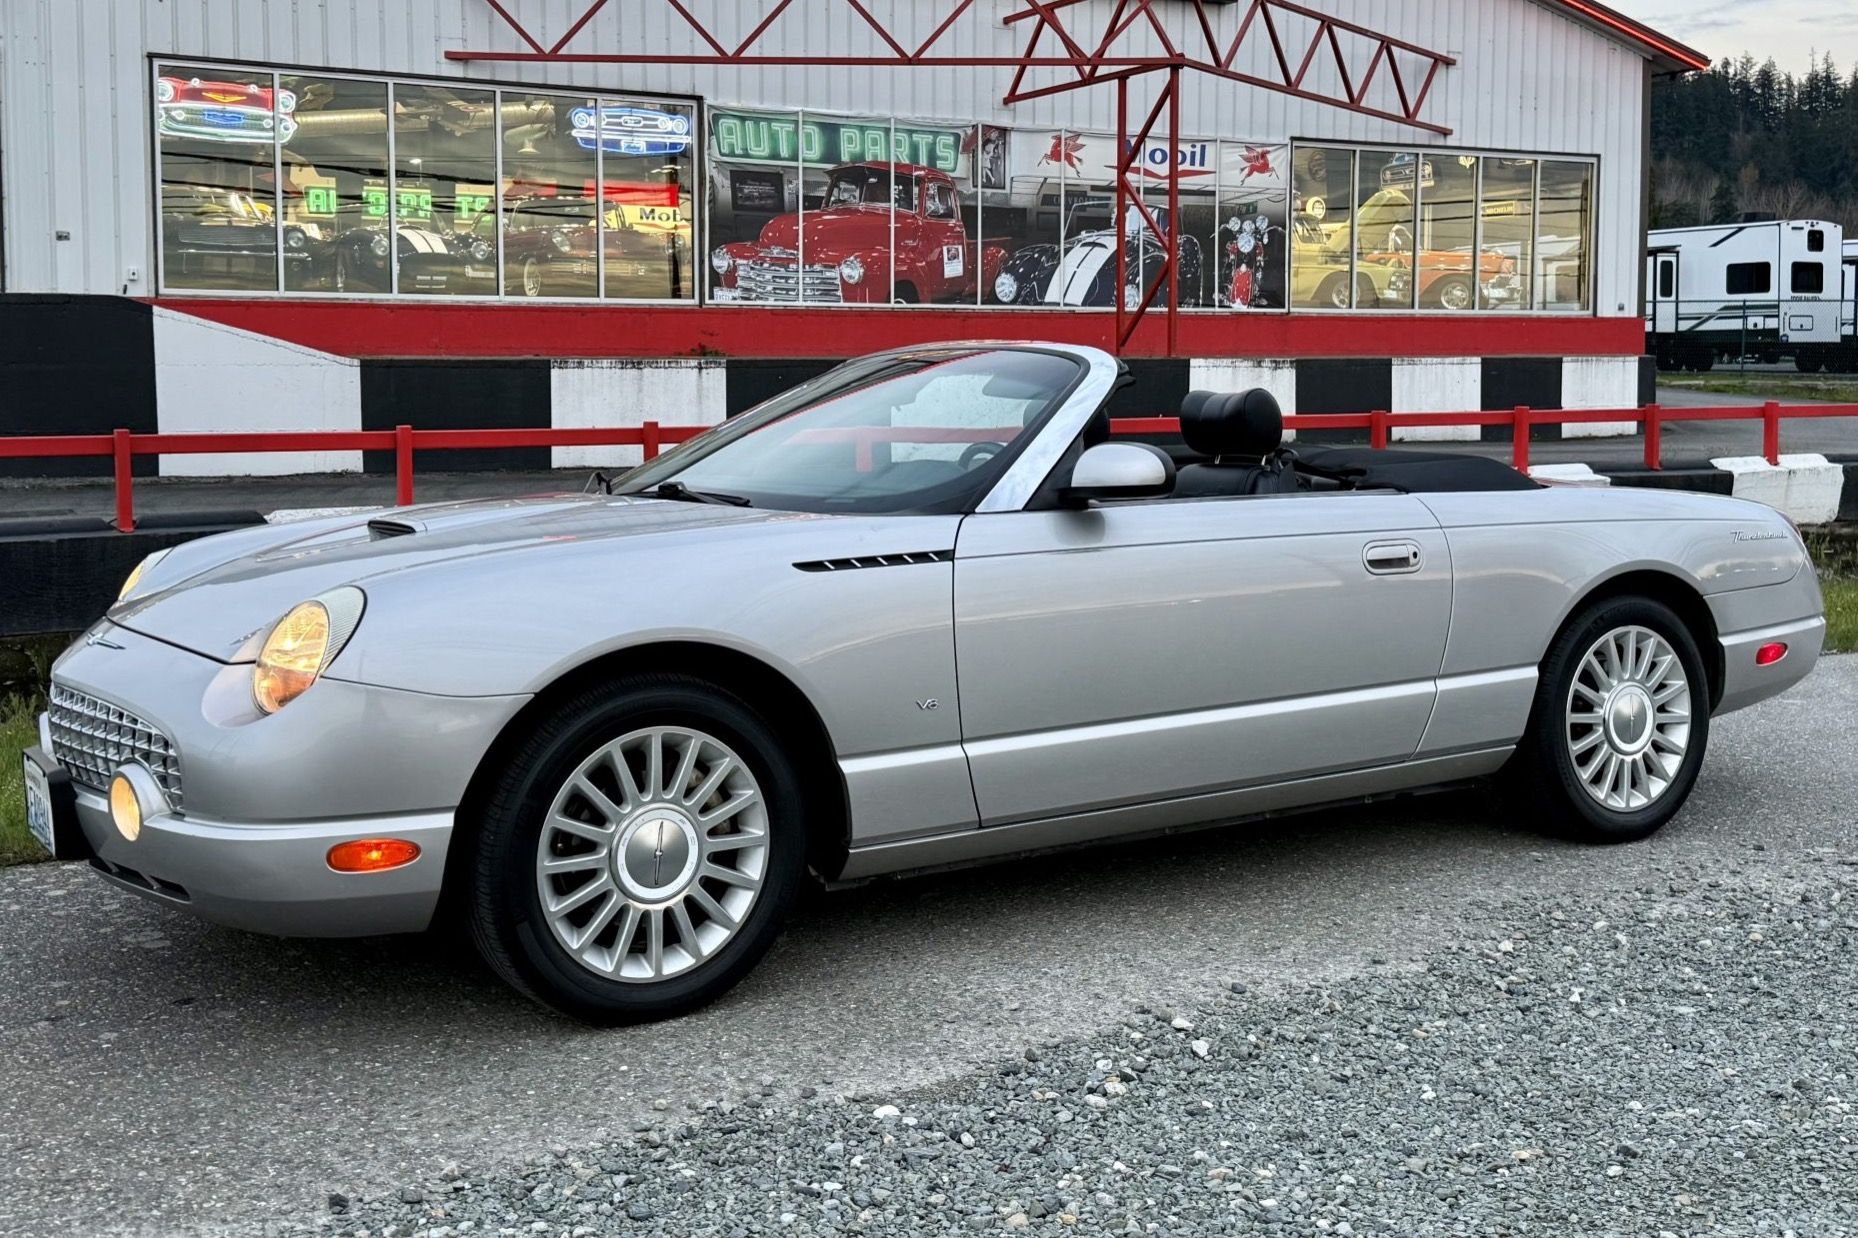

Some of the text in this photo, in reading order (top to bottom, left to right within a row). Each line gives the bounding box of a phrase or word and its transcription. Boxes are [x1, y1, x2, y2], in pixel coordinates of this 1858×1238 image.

[718, 117, 955, 173] AUTO PARTS
[1730, 530, 1788, 543] Thunderbird
